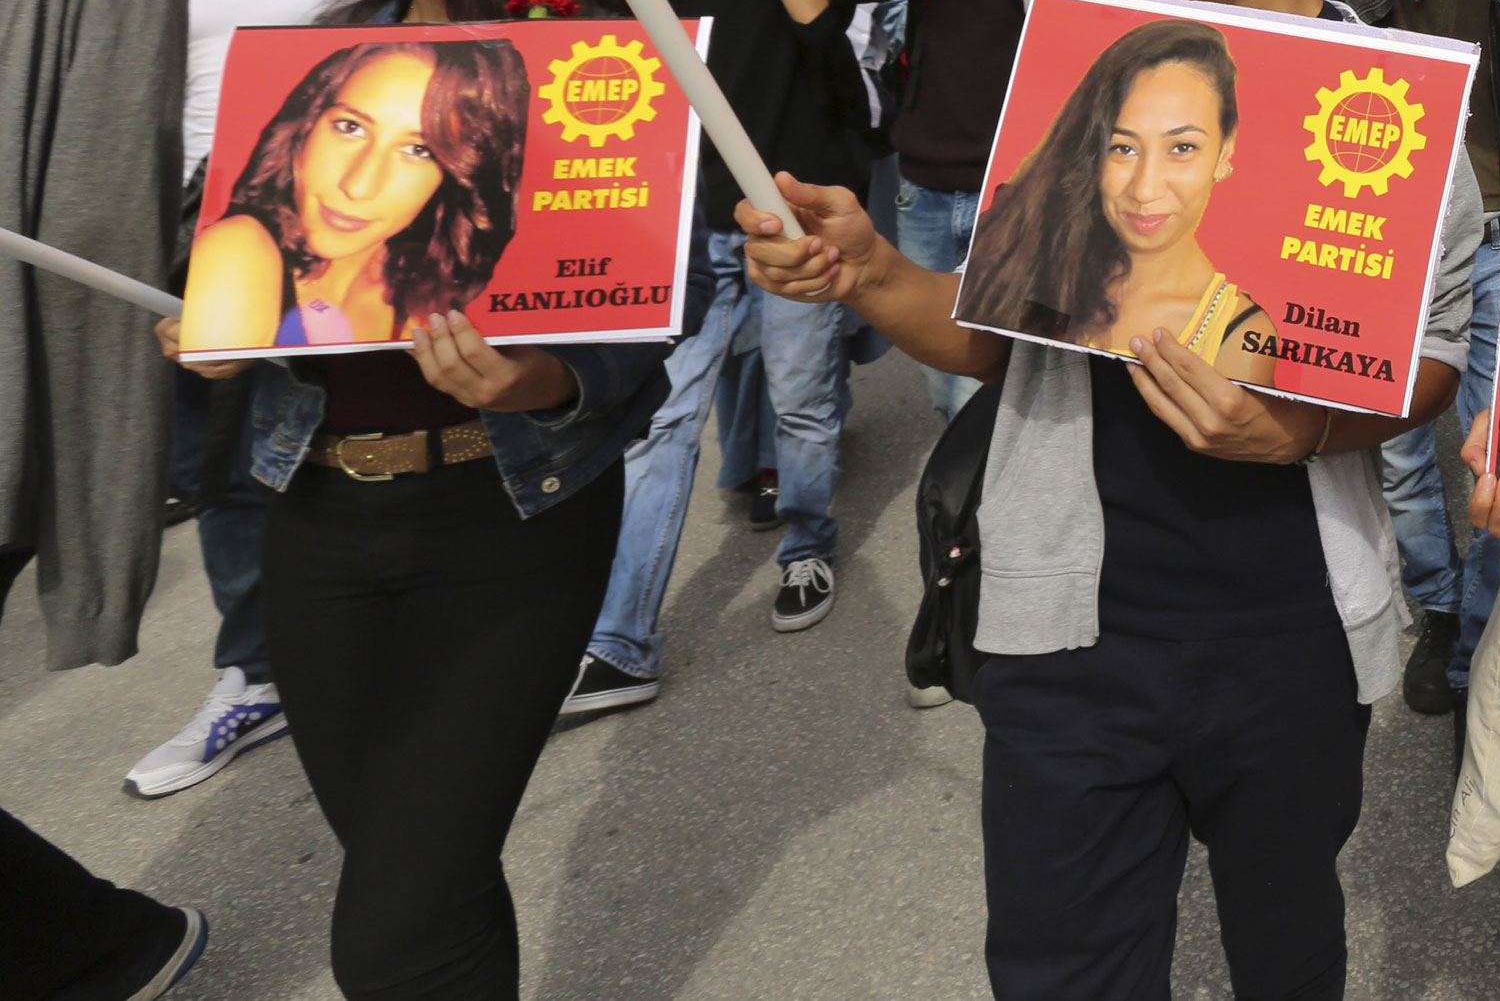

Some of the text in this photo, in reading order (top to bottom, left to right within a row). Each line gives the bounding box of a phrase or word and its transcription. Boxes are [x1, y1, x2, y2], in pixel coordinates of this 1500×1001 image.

[566, 78, 640, 102] EMEP
[1329, 114, 1403, 150] EMEP
[553, 156, 637, 180] EMEK
[532, 181, 649, 212] PARTİSİ
[1303, 203, 1388, 241] EMEK
[556, 257, 613, 279] Elif
[1280, 235, 1395, 280] PARTİSİ
[488, 280, 672, 313] KANLIOĞLU
[1283, 302, 1361, 338] Dilan
[1241, 330, 1396, 383] SARIKAYA
